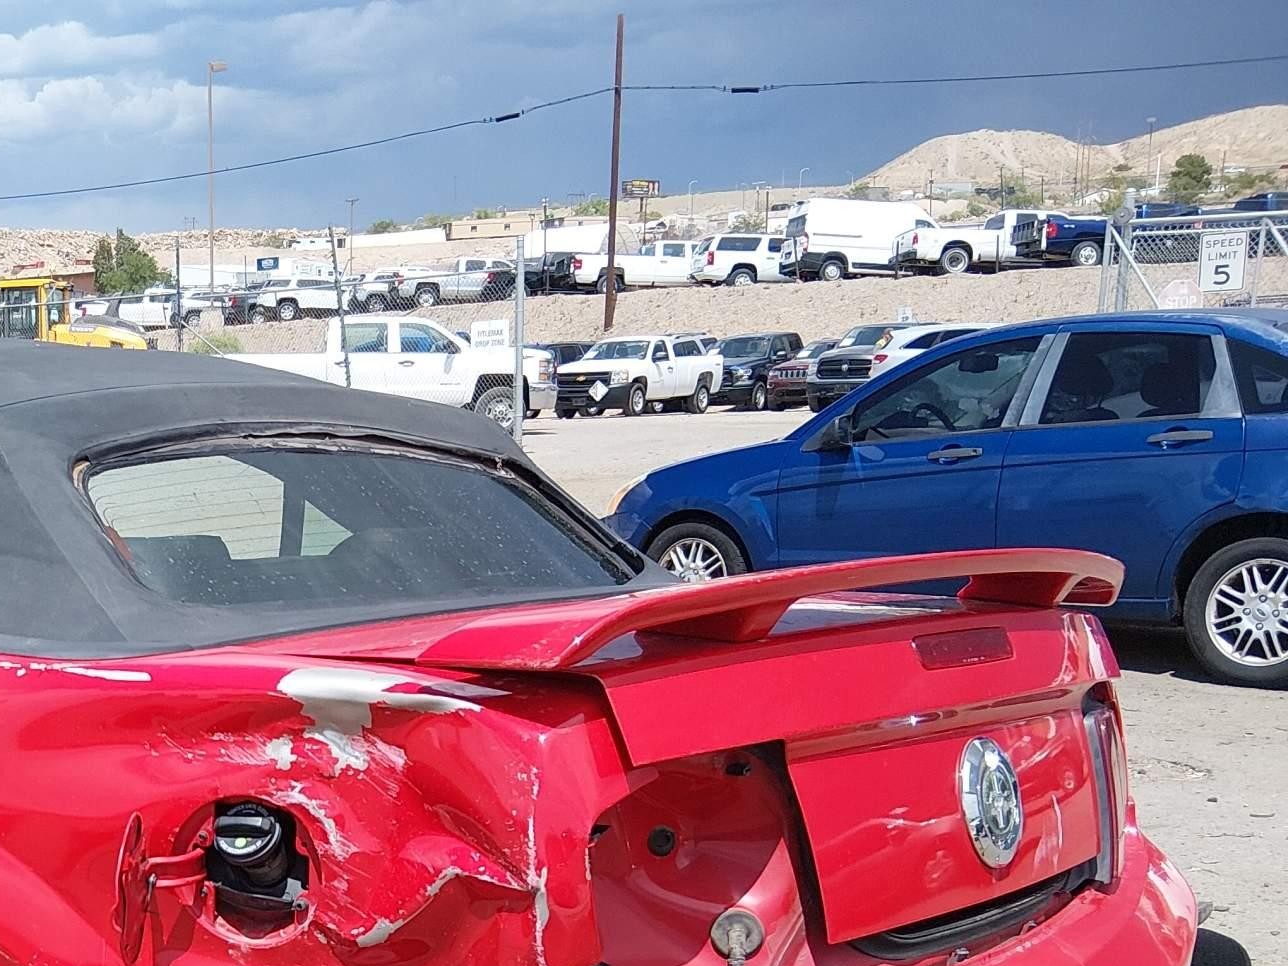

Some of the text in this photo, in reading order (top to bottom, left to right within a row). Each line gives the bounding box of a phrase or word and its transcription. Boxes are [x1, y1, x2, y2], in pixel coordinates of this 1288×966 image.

[1205, 237, 1244, 249] SPEED
[1208, 250, 1239, 261] LIMIT
[1213, 264, 1230, 285] 5
[1167, 296, 1197, 306] STOP
